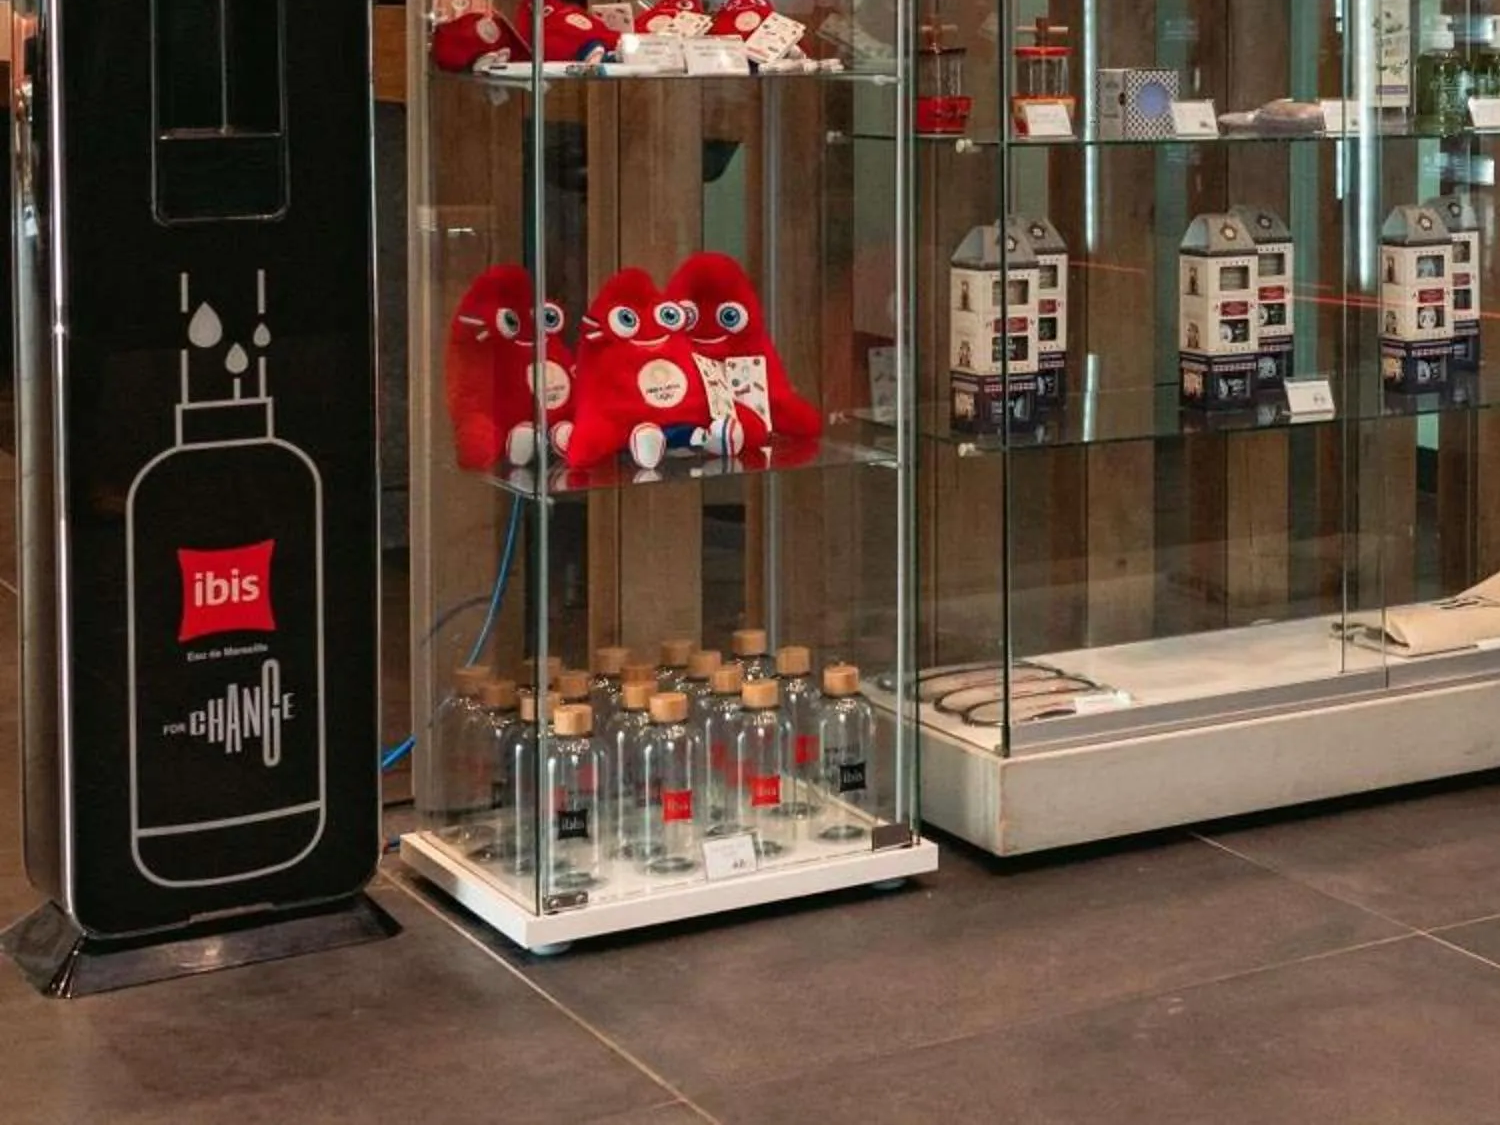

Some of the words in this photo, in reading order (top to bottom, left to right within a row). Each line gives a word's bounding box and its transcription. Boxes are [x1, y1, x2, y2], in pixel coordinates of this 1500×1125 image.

[194, 567, 261, 607] ibis
[163, 722, 186, 735] FOR
[189, 658, 296, 768] CHANGE
